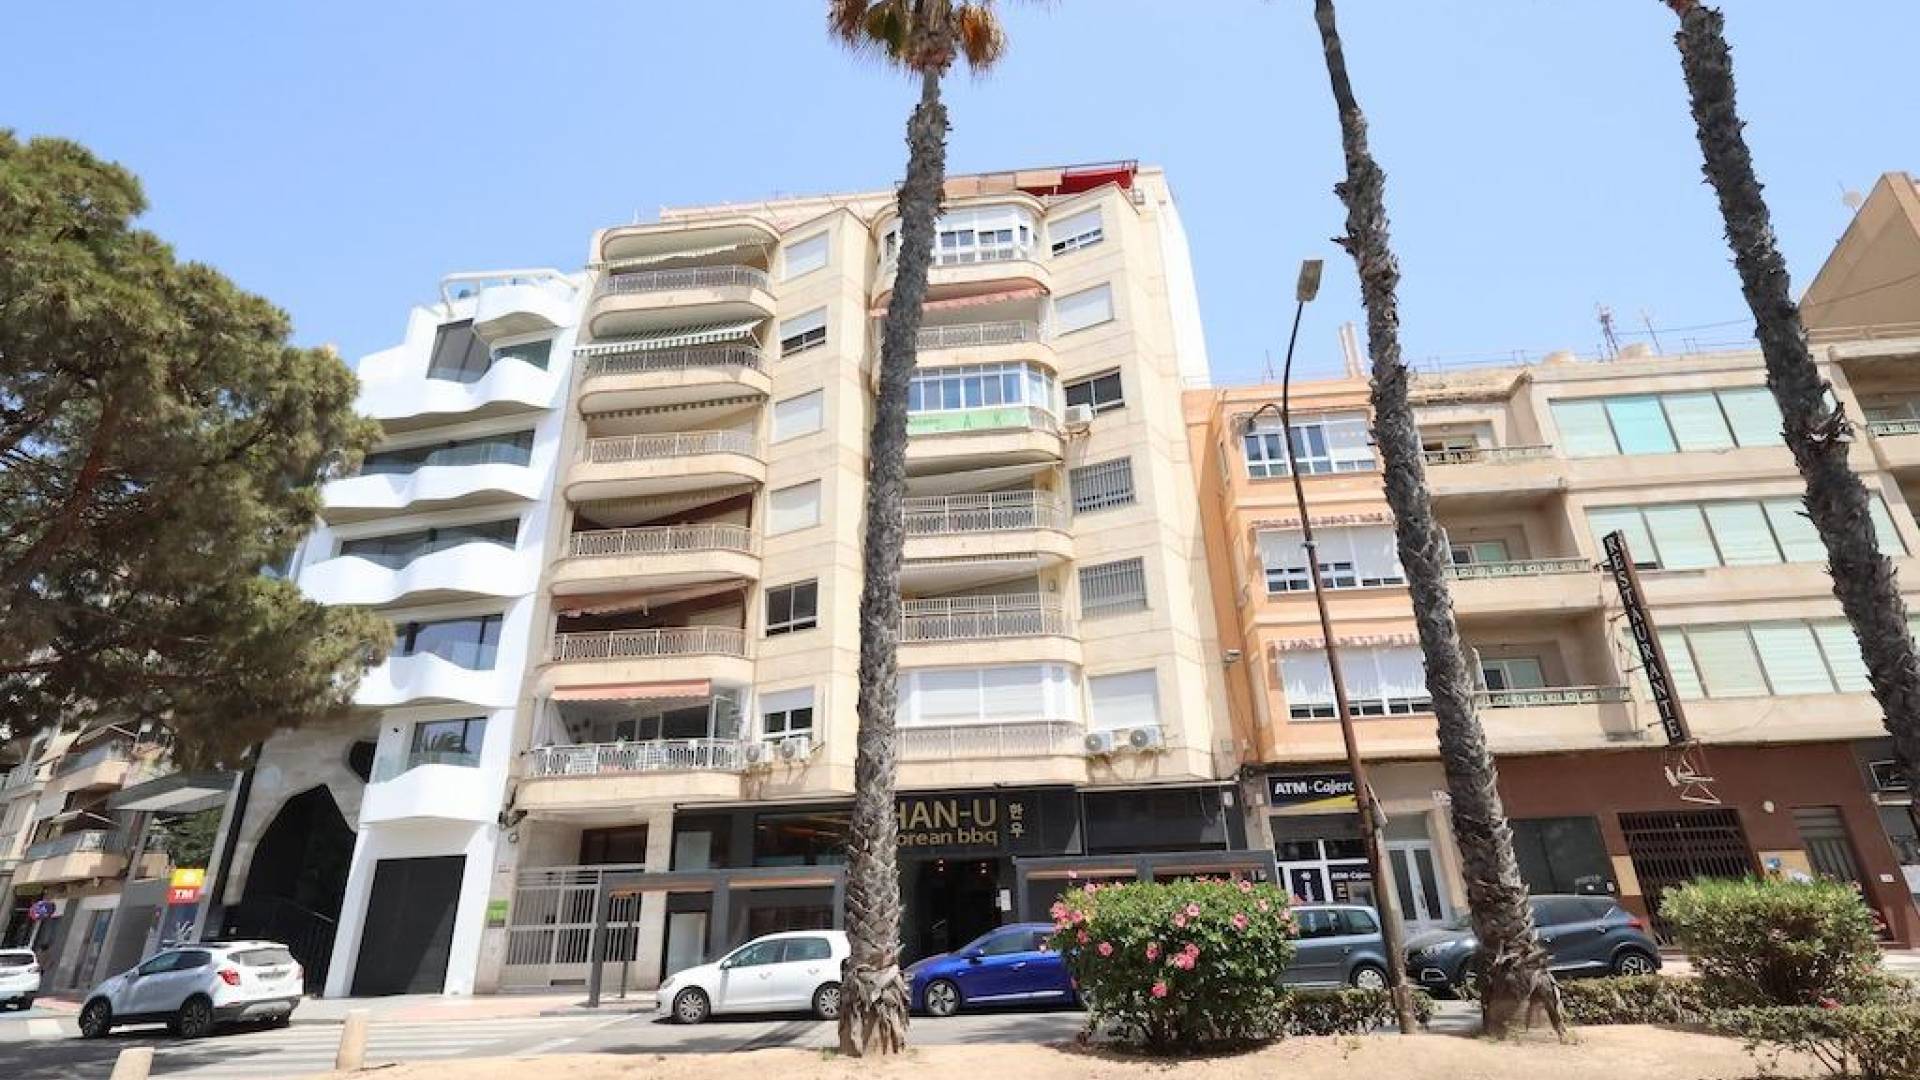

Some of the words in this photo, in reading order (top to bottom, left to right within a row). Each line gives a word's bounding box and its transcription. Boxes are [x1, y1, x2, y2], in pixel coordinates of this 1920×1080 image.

[1606, 534, 1681, 739] RESTAURANTE
[1275, 782, 1307, 794] ATM
[896, 830, 953, 847] orean
[957, 827, 998, 848] bbq
